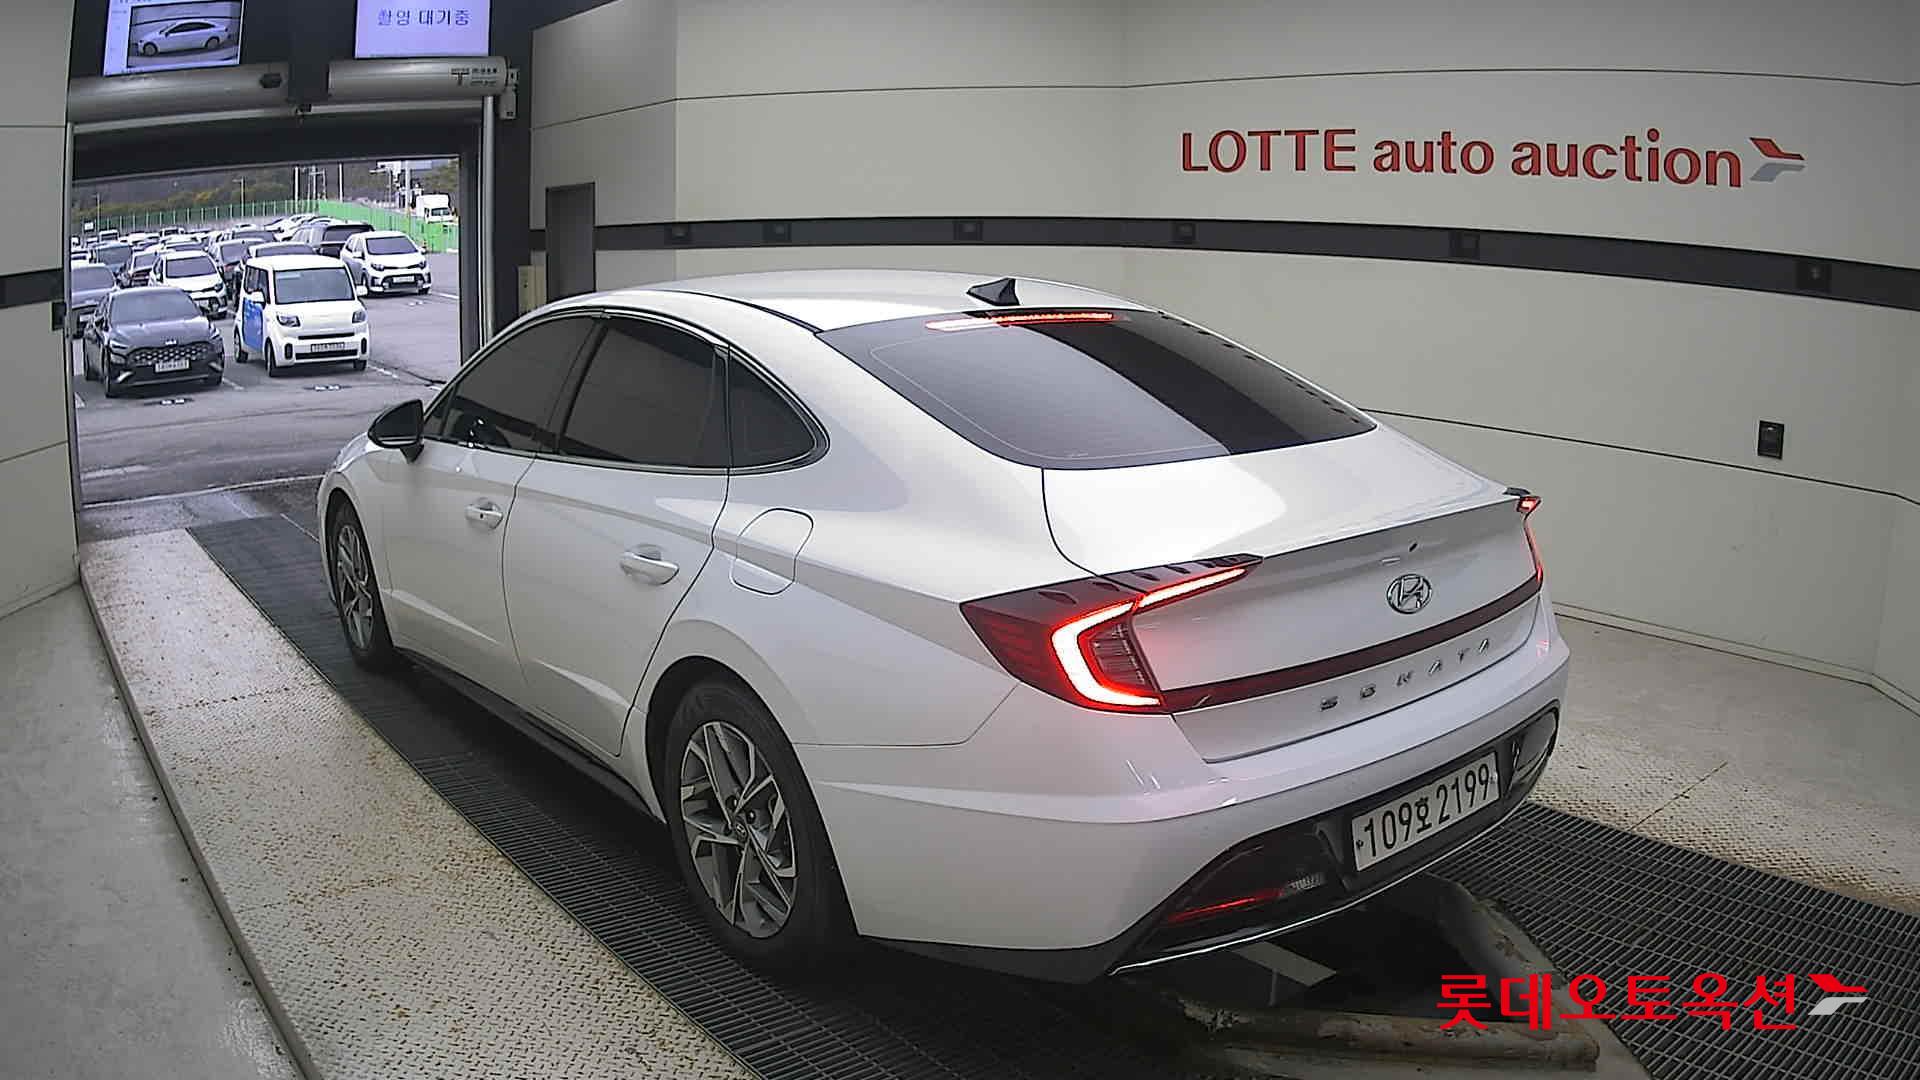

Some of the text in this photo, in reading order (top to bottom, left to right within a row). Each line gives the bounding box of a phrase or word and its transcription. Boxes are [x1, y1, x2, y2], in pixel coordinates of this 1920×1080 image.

[1182, 128, 1743, 188] LOTTE auto auction
[1319, 638, 1491, 712] SONATA
